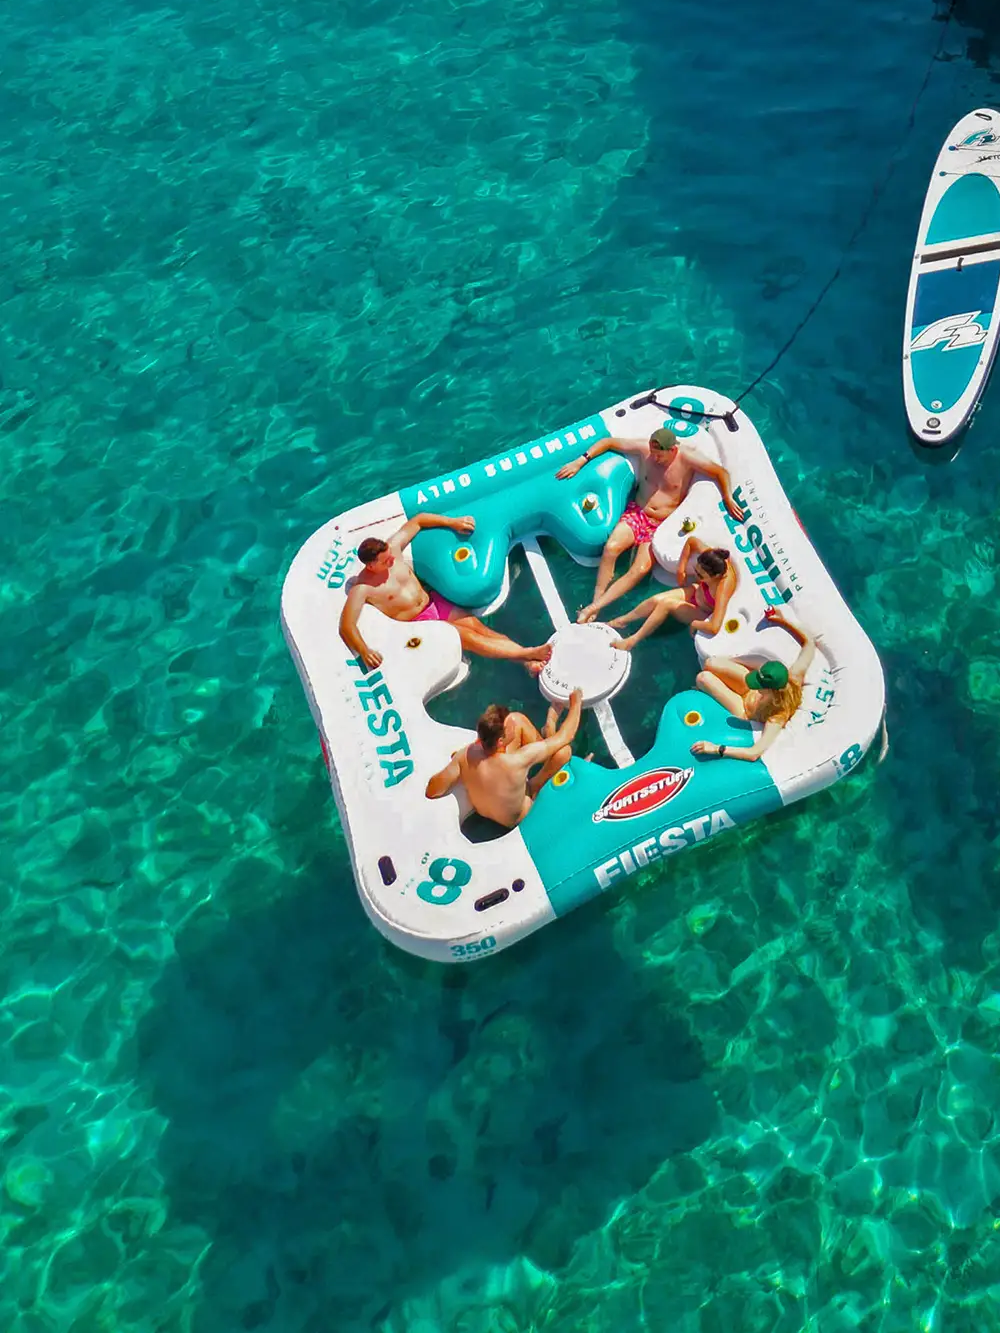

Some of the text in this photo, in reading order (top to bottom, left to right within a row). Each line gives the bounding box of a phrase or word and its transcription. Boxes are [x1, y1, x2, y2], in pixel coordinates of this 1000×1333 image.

[416, 424, 597, 505] MEMBERS ONLY
[744, 478, 804, 592] PRIVATE ISLAND
[592, 766, 695, 824] SPORTSSTUFF
[593, 808, 737, 890] FIESTA
[449, 934, 497, 957] 350
